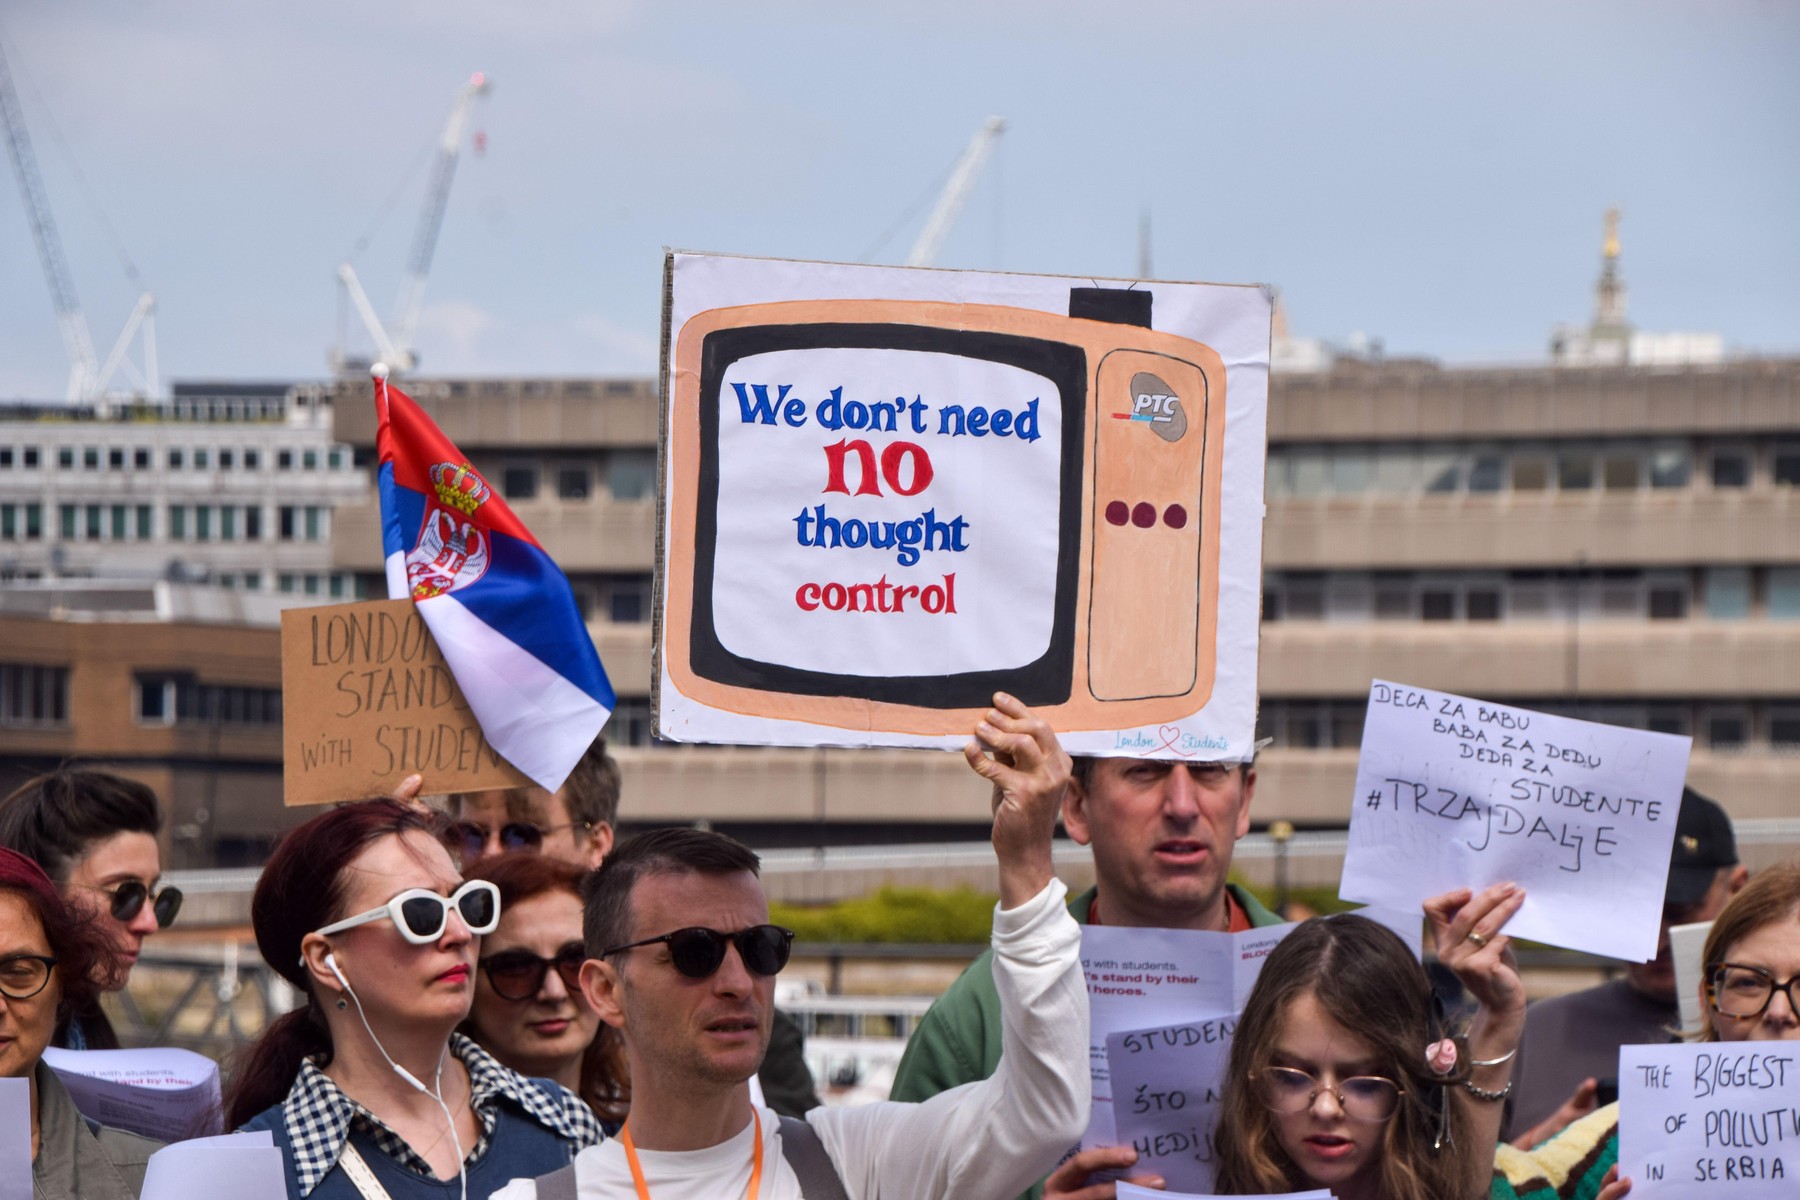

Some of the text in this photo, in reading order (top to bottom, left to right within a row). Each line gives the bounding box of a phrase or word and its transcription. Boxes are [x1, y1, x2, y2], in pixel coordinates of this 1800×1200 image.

[730, 382, 1042, 444] We don't need
[821, 436, 935, 498] no
[792, 503, 970, 567] thought
[795, 572, 958, 615] control
[335, 664, 469, 719] STAND
[1438, 698, 1467, 720] ZA
[1478, 706, 1530, 731] BABU
[1113, 731, 1158, 750] London
[1432, 718, 1488, 744] BABA
[1501, 735, 1536, 754] ZA
[1459, 743, 1554, 777] DEDA ZA
[1510, 777, 1663, 822] STUDENTE
[1093, 960, 1118, 969] with
[1102, 973, 1142, 983] stand
[1146, 974, 1163, 985] by
[1166, 974, 1200, 985] their
[1636, 1053, 1794, 1099] THE BIGGEST
[1664, 1112, 1688, 1134] OF
[1646, 1155, 1785, 1182] IN SERBIA
